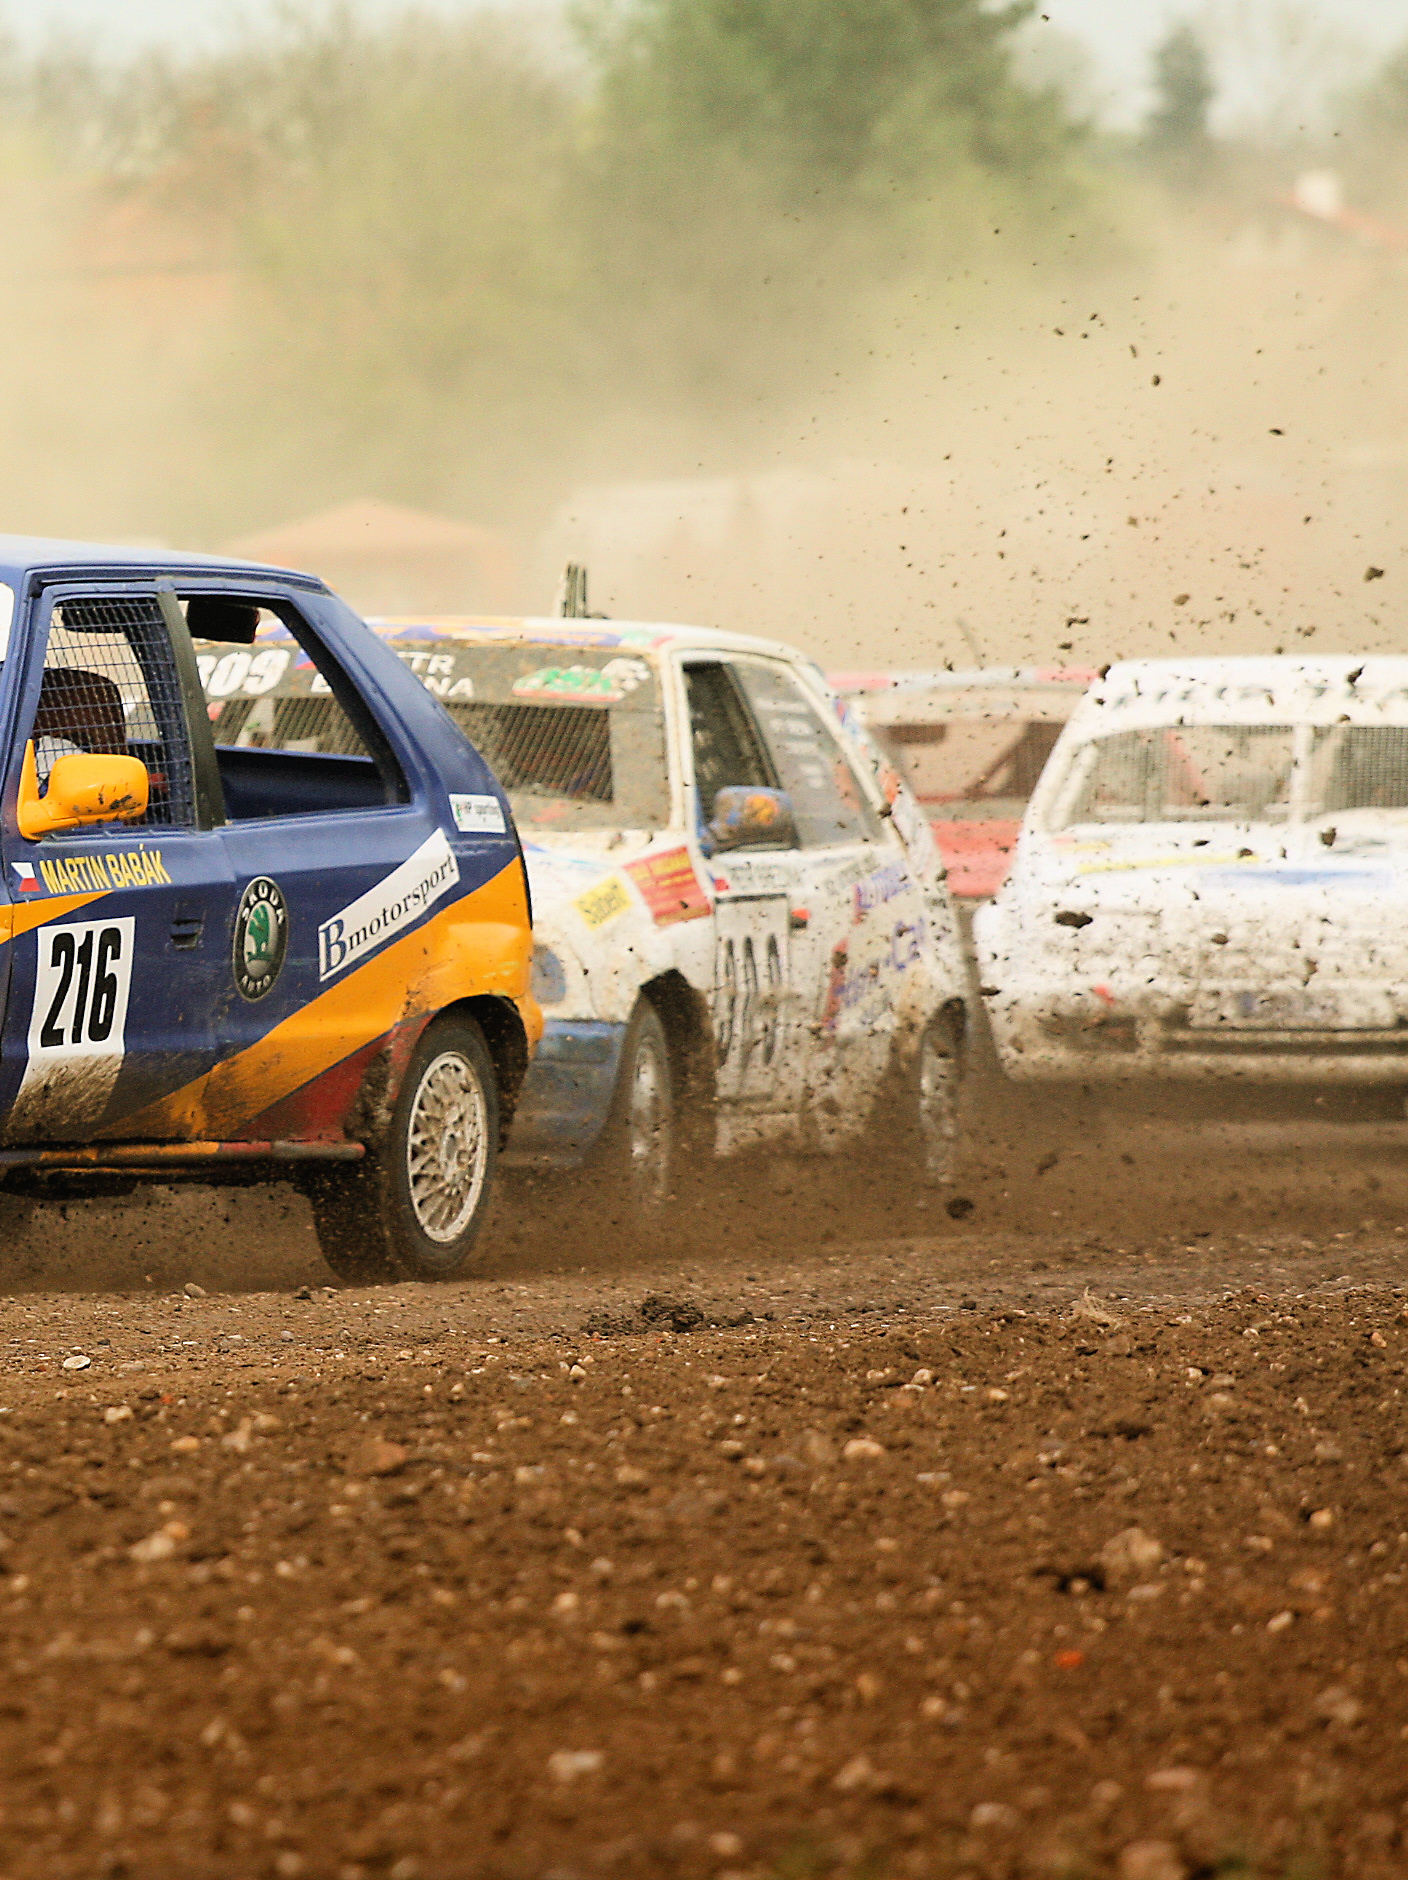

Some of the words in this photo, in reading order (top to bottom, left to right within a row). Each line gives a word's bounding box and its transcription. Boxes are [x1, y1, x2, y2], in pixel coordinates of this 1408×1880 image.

[39, 855, 112, 893] MARTIN
[105, 843, 172, 888] BABÁK
[40, 927, 122, 1048] 216
